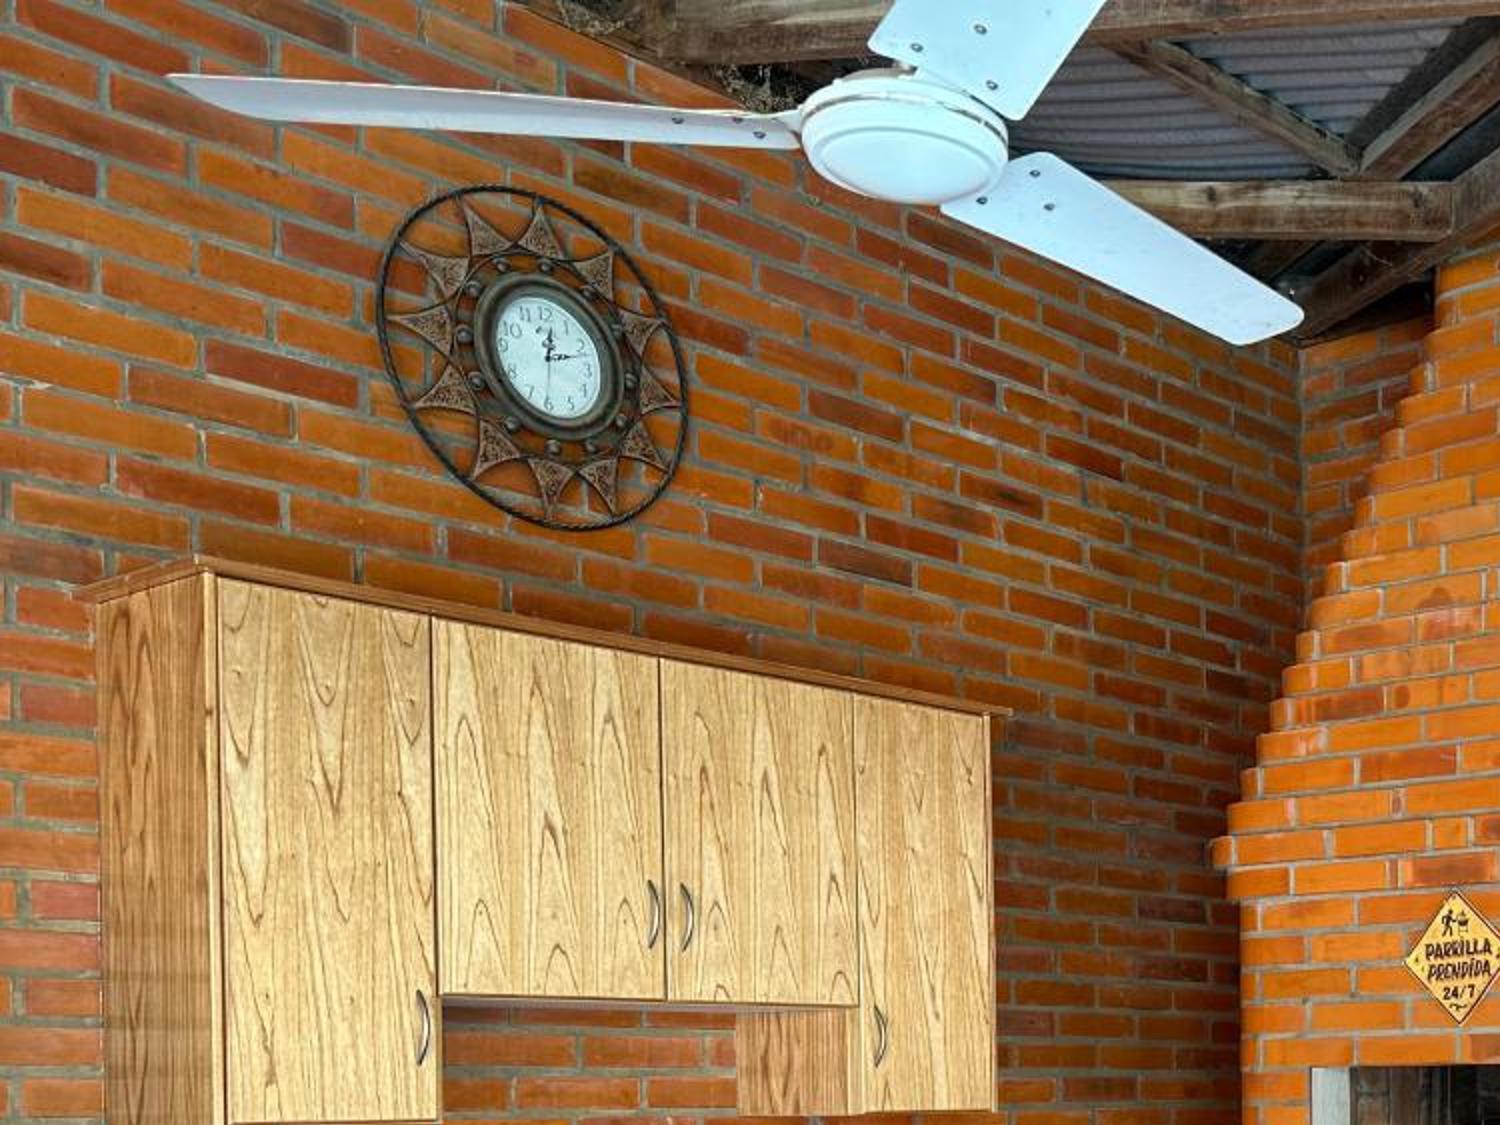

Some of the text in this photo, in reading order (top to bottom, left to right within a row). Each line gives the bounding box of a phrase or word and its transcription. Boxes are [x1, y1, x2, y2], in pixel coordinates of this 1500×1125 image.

[538, 306, 552, 320] 12
[502, 320, 522, 338] 10
[544, 397, 553, 411] 6
[1425, 937, 1492, 960] PARRILLA
[1427, 958, 1492, 982] PRENDIDA
[1443, 984, 1475, 1000] 24/7
